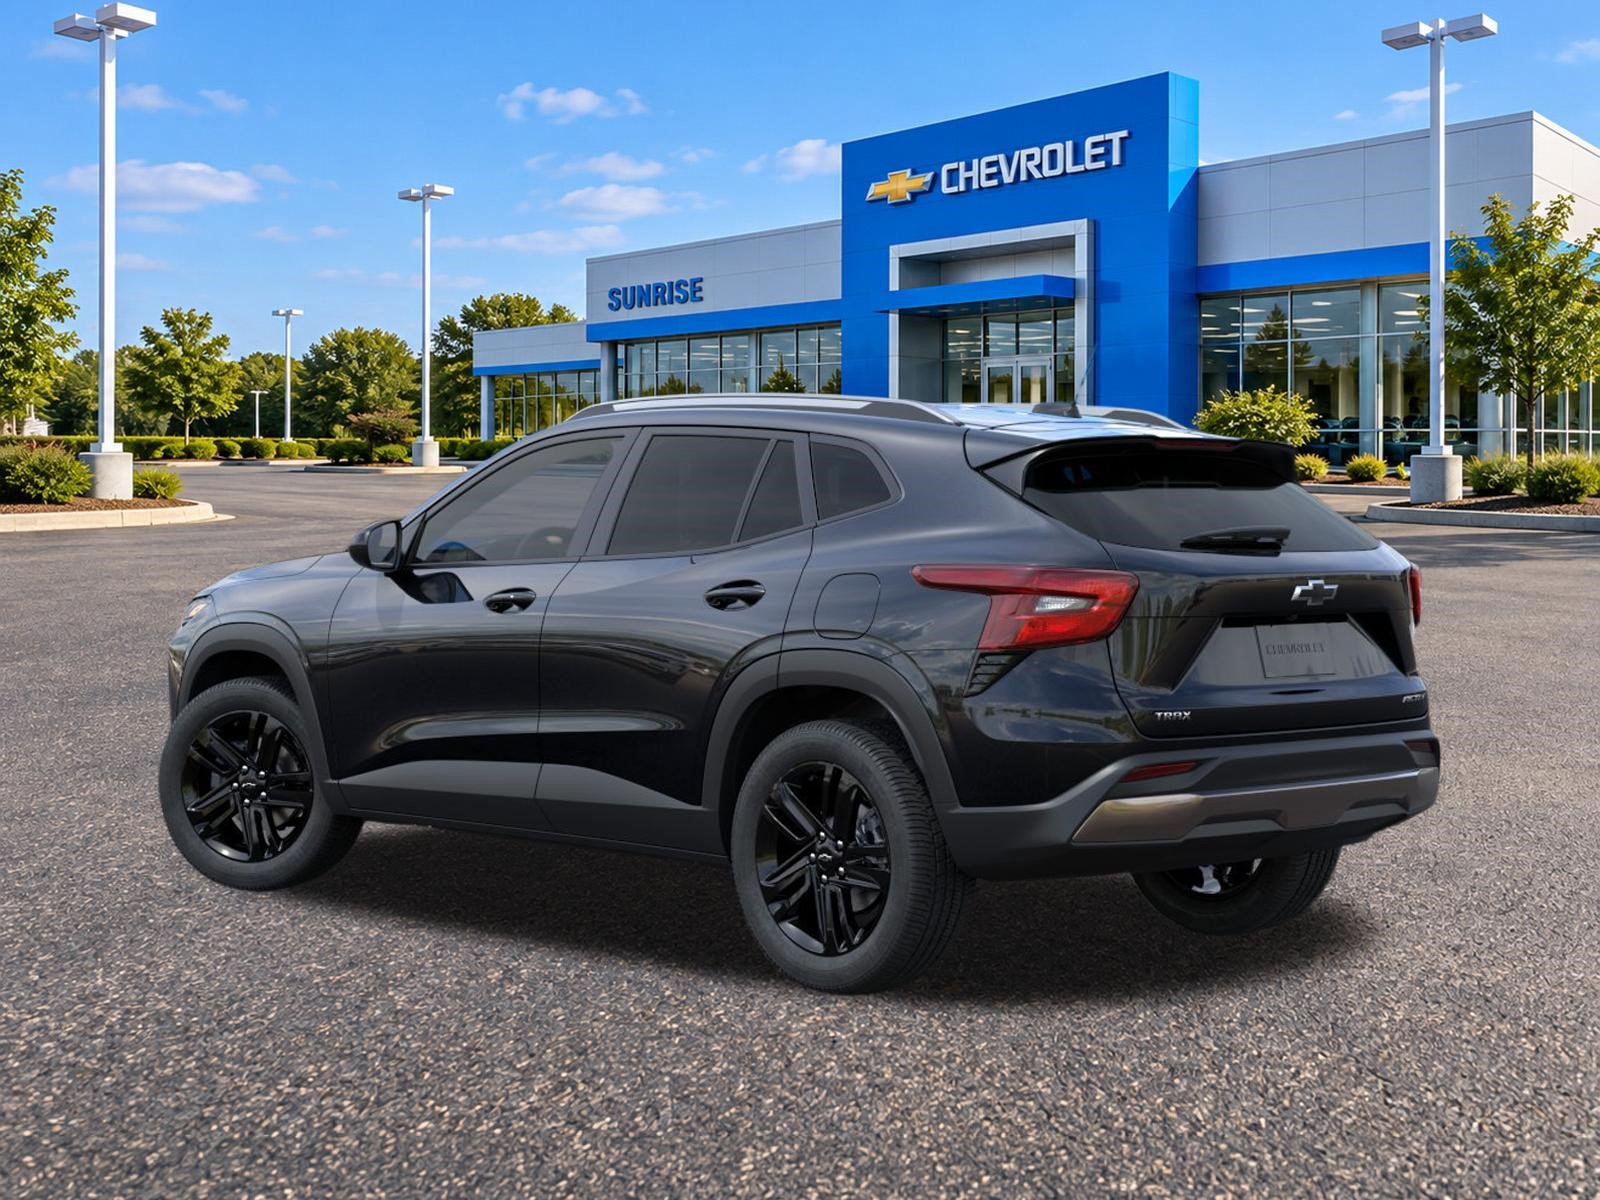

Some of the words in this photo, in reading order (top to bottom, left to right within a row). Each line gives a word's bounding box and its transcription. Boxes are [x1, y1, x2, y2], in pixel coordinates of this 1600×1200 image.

[941, 130, 1129, 194] CHEVROLET
[608, 277, 704, 312] SUNRISE
[1154, 711, 1191, 720] TRAX
